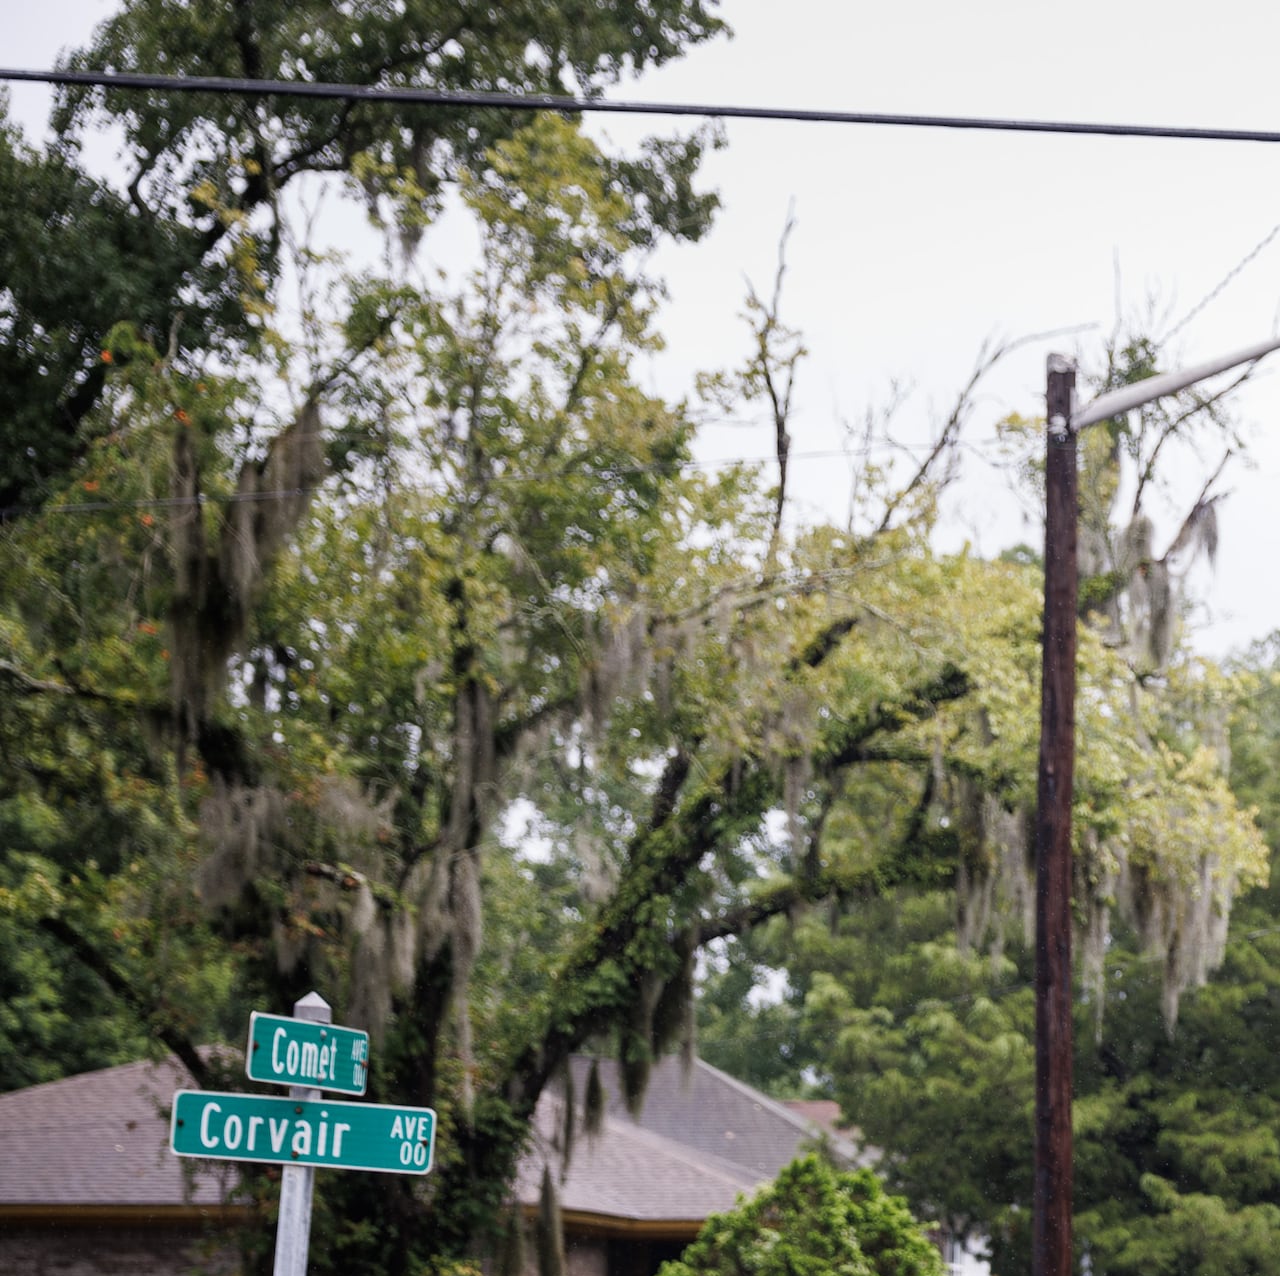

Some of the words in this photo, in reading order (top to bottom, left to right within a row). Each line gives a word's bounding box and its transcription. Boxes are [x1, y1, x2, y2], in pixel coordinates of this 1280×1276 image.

[271, 1026, 338, 1081] Comet
[200, 1101, 351, 1158] Corvair
[389, 1115, 429, 1142] AVE
